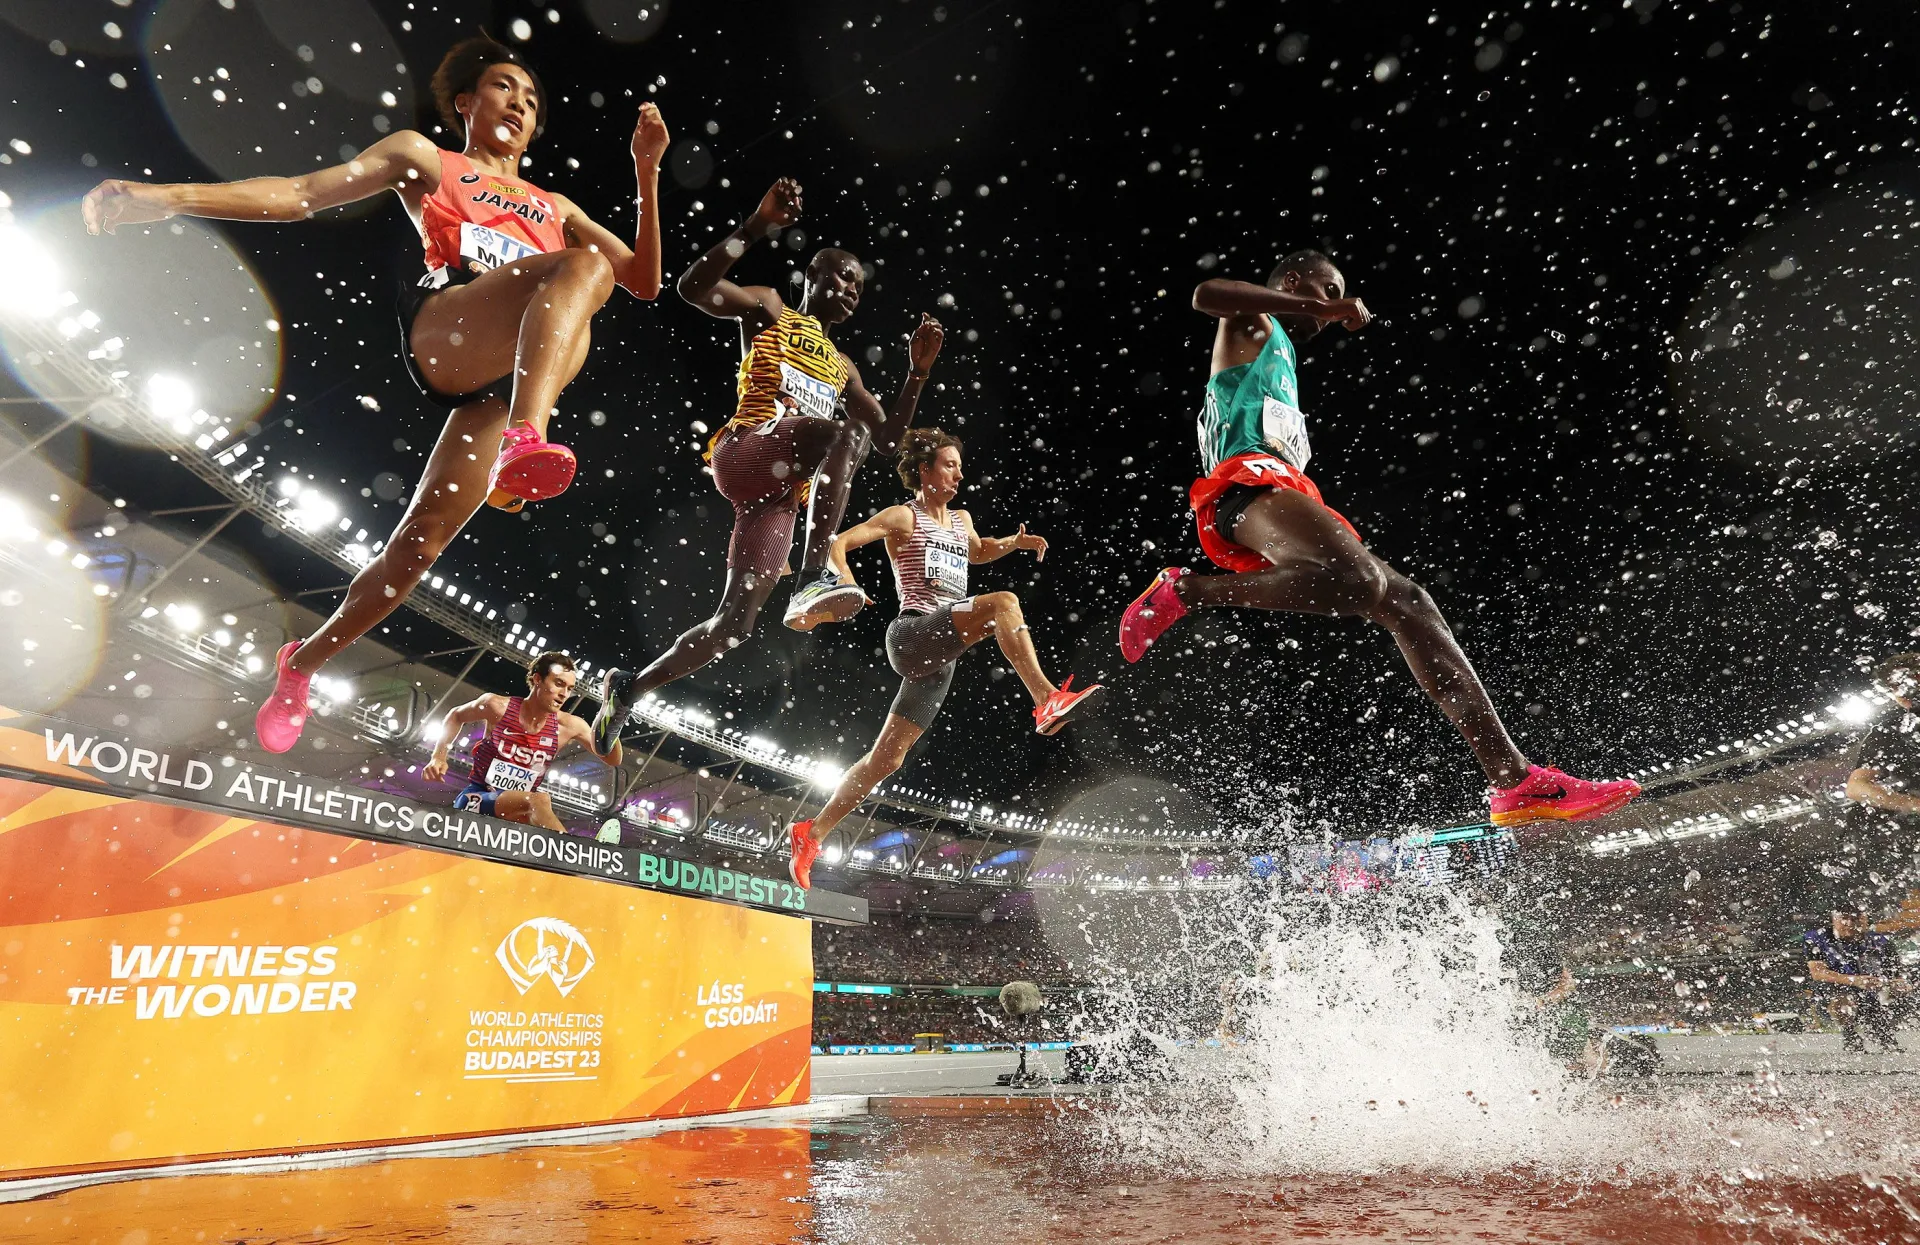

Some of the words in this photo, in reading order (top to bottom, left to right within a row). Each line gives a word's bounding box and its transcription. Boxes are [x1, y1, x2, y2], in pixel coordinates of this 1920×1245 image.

[473, 191, 545, 224] JAPAN
[941, 552, 965, 571] TDK
[498, 740, 547, 766] USA
[492, 774, 527, 791] ROOKS
[507, 764, 535, 782] TDK
[44, 729, 213, 790] WORLD
[225, 771, 415, 831] ATHLETICS
[423, 812, 623, 874] CHAMPIONSHIPS
[639, 853, 777, 906] BUDAPEST
[781, 883, 806, 910] 23
[110, 945, 338, 979] WITNESS
[67, 987, 125, 1005] THE
[135, 981, 357, 1019] WONDER
[697, 980, 744, 1007] LÁSS
[470, 1010, 526, 1027] WORLD
[528, 1012, 603, 1029] ATHLETICS
[704, 1002, 777, 1029] CSODÁT!
[465, 1030, 602, 1047] CHAMPIONSHIPS
[464, 1051, 576, 1071] BUDAPEST
[580, 1051, 600, 1069] 23
